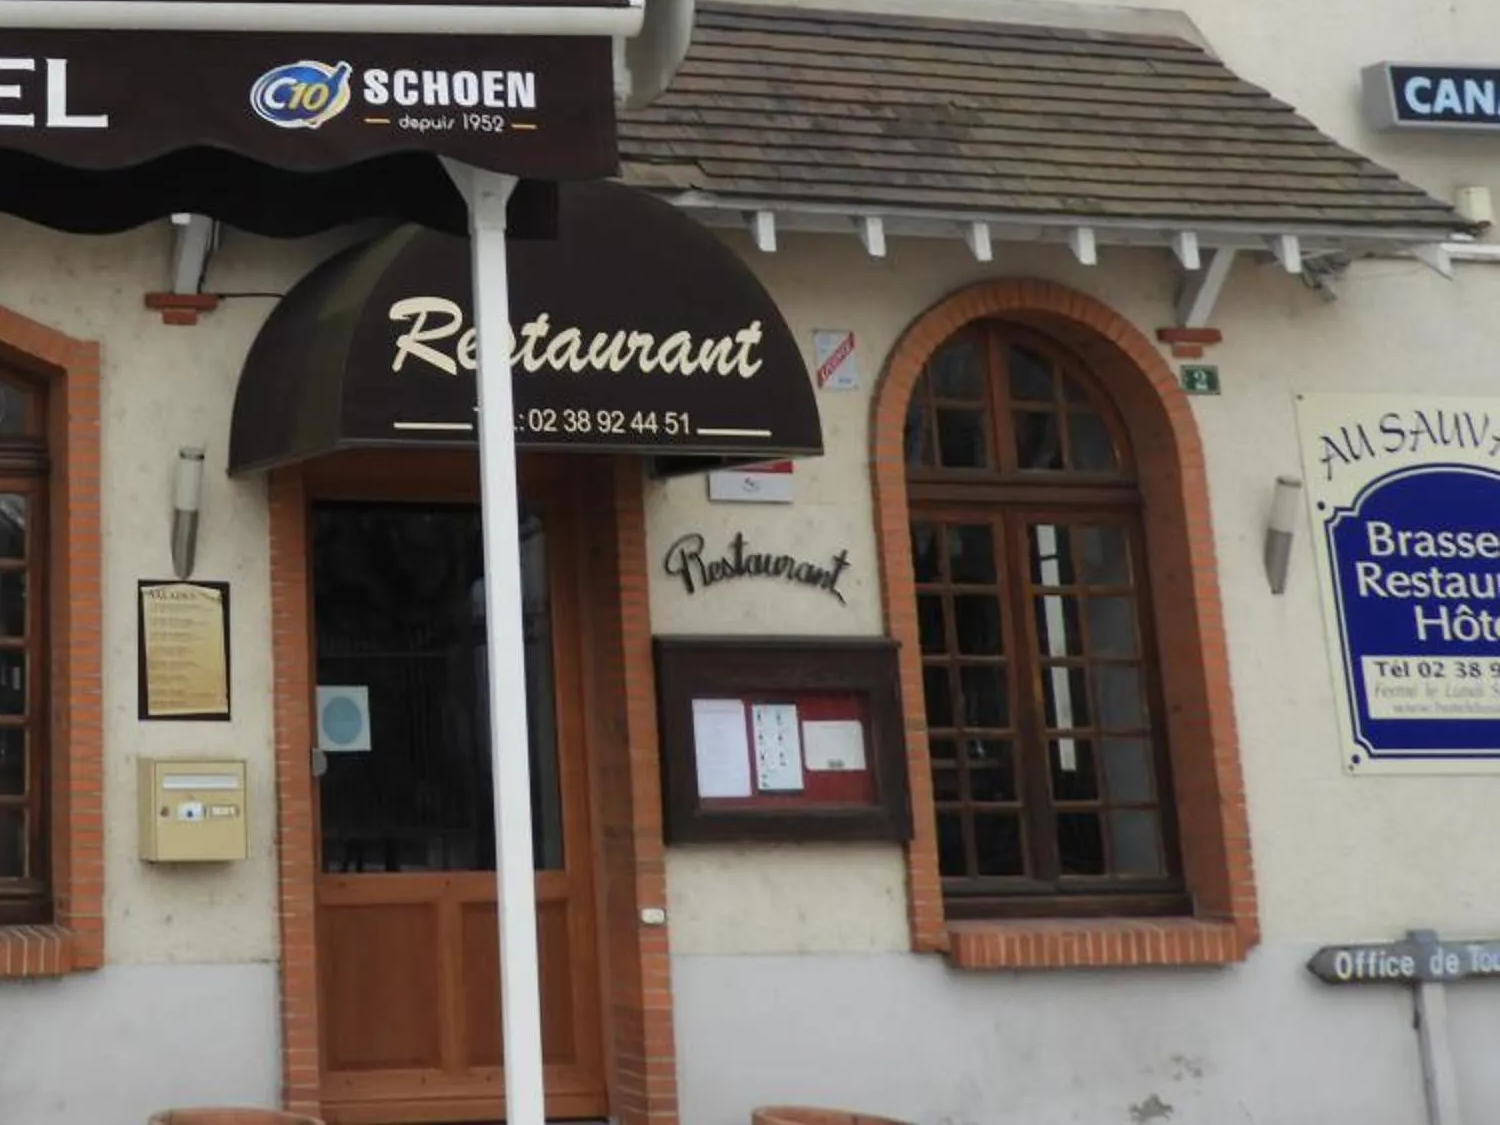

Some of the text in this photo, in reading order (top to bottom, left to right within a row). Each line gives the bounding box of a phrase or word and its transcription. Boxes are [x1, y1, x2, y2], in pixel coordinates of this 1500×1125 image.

[263, 77, 329, 111] C10
[363, 69, 537, 109] SCHOEN
[1404, 76, 1500, 115] CAN
[399, 113, 505, 132] depuis 1952
[389, 296, 763, 378] Retaurant
[529, 409, 557, 432] 02
[563, 410, 592, 433] 38
[597, 411, 626, 434] 92
[630, 412, 658, 435] 44
[664, 412, 691, 435] 51
[1320, 423, 1376, 481] AU
[664, 531, 851, 607] Restaurant
[1355, 561, 1500, 599] Restau
[1417, 660, 1445, 678] 02
[1455, 660, 1482, 679] 38
[1334, 950, 1416, 980] Office
[1429, 946, 1460, 975] de
